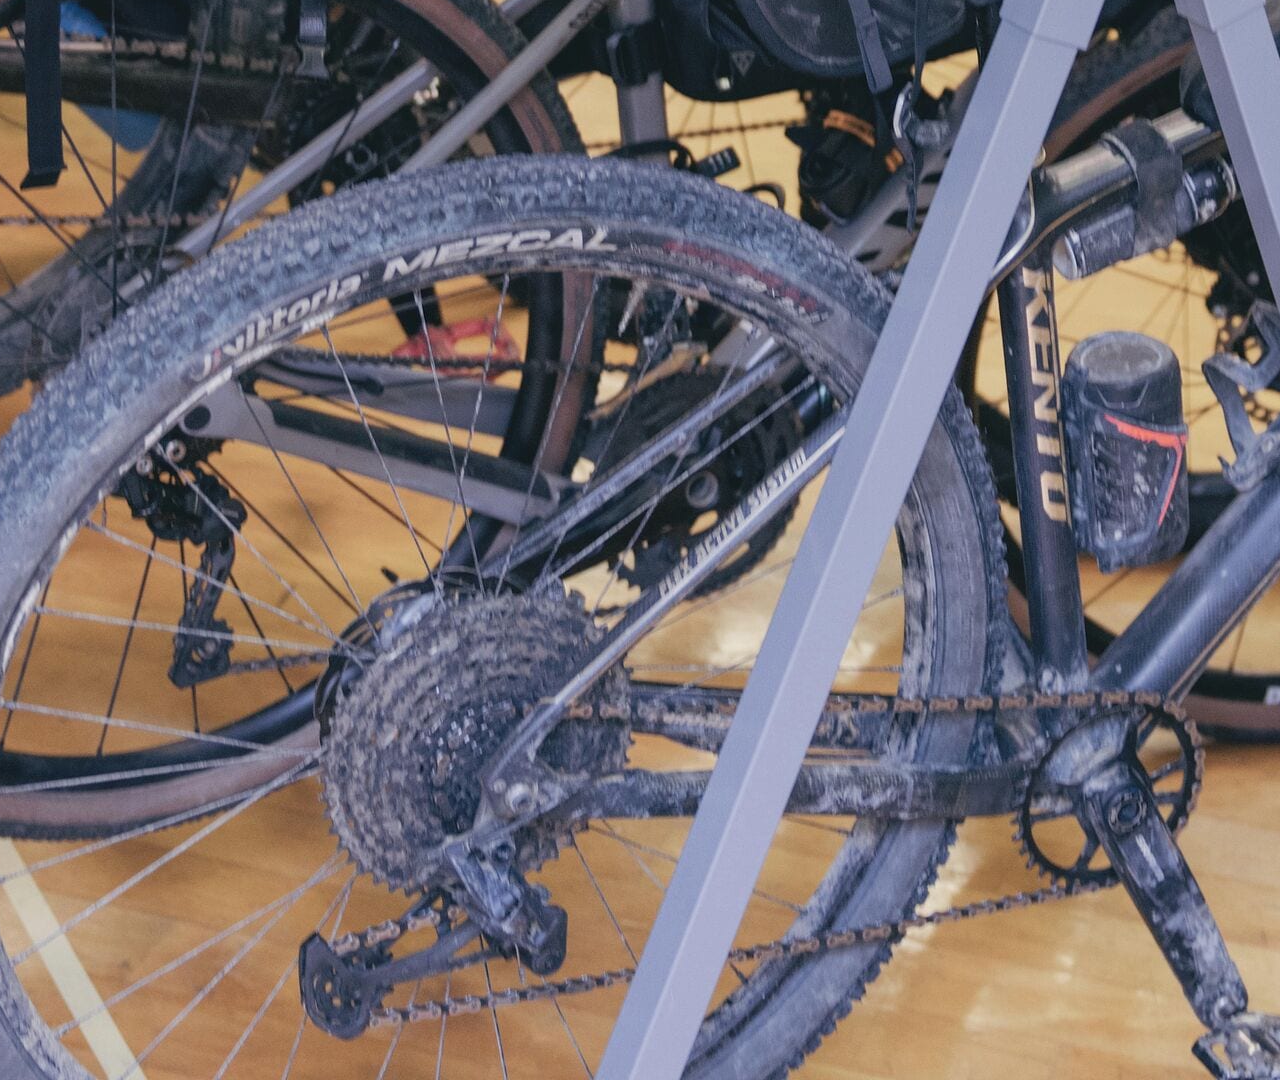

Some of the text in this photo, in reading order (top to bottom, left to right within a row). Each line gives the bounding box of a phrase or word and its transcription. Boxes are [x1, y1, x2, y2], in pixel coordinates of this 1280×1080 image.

[222, 226, 619, 357] vittoria MEZCAL
[695, 504, 748, 563] ACTIVE
[747, 446, 808, 510] SYSTEM
